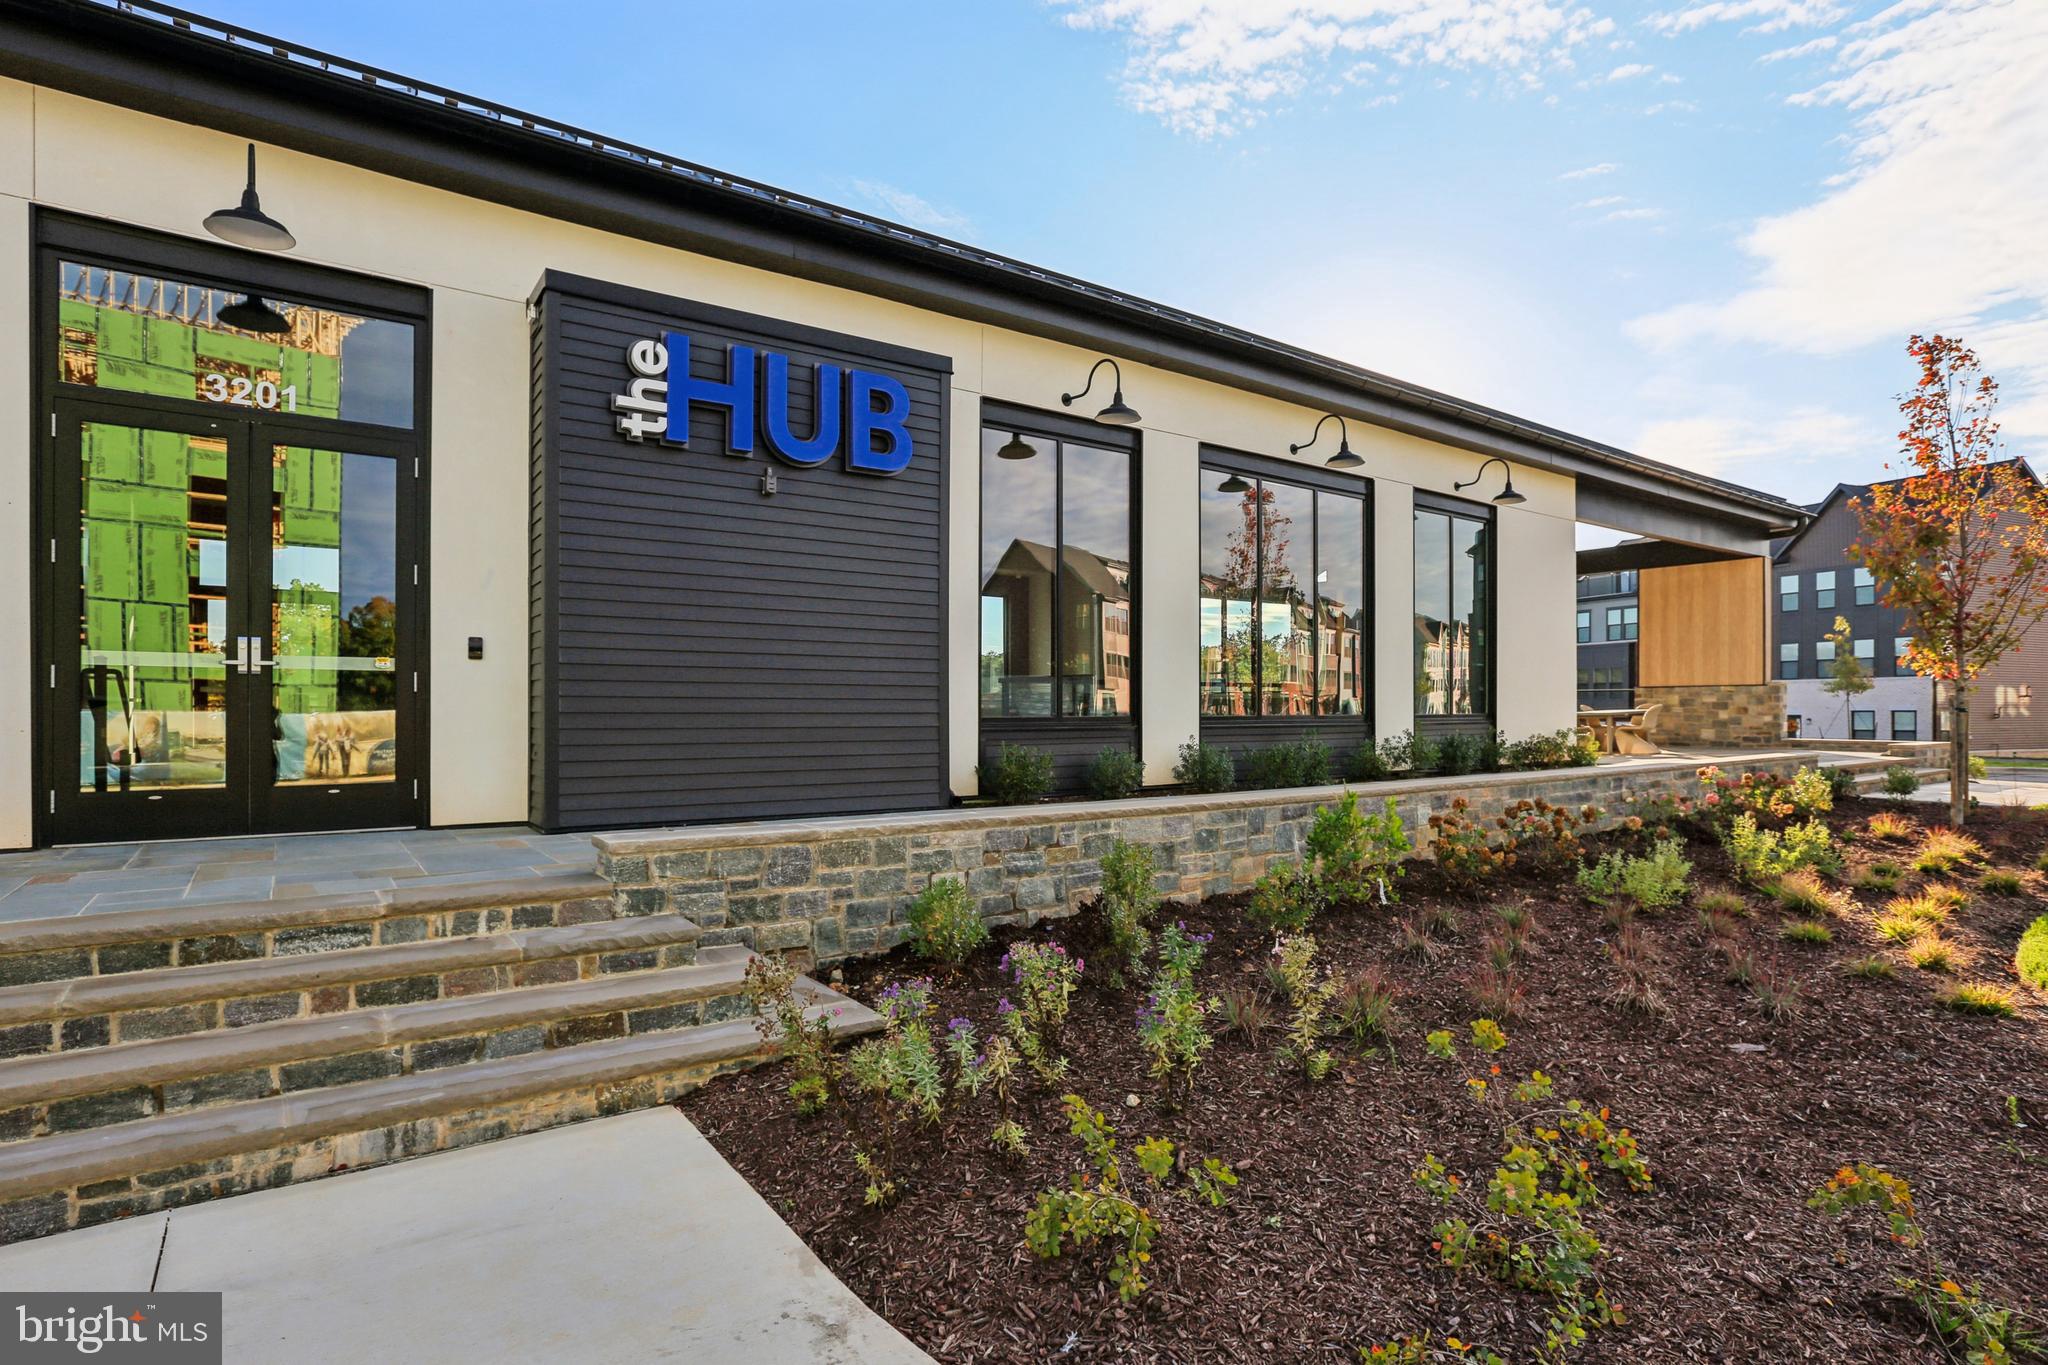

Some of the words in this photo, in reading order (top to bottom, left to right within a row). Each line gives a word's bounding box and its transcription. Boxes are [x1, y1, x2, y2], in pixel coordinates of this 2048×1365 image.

[206, 374, 296, 411] 3201
[612, 338, 668, 440] the
[662, 330, 914, 475] HUB
